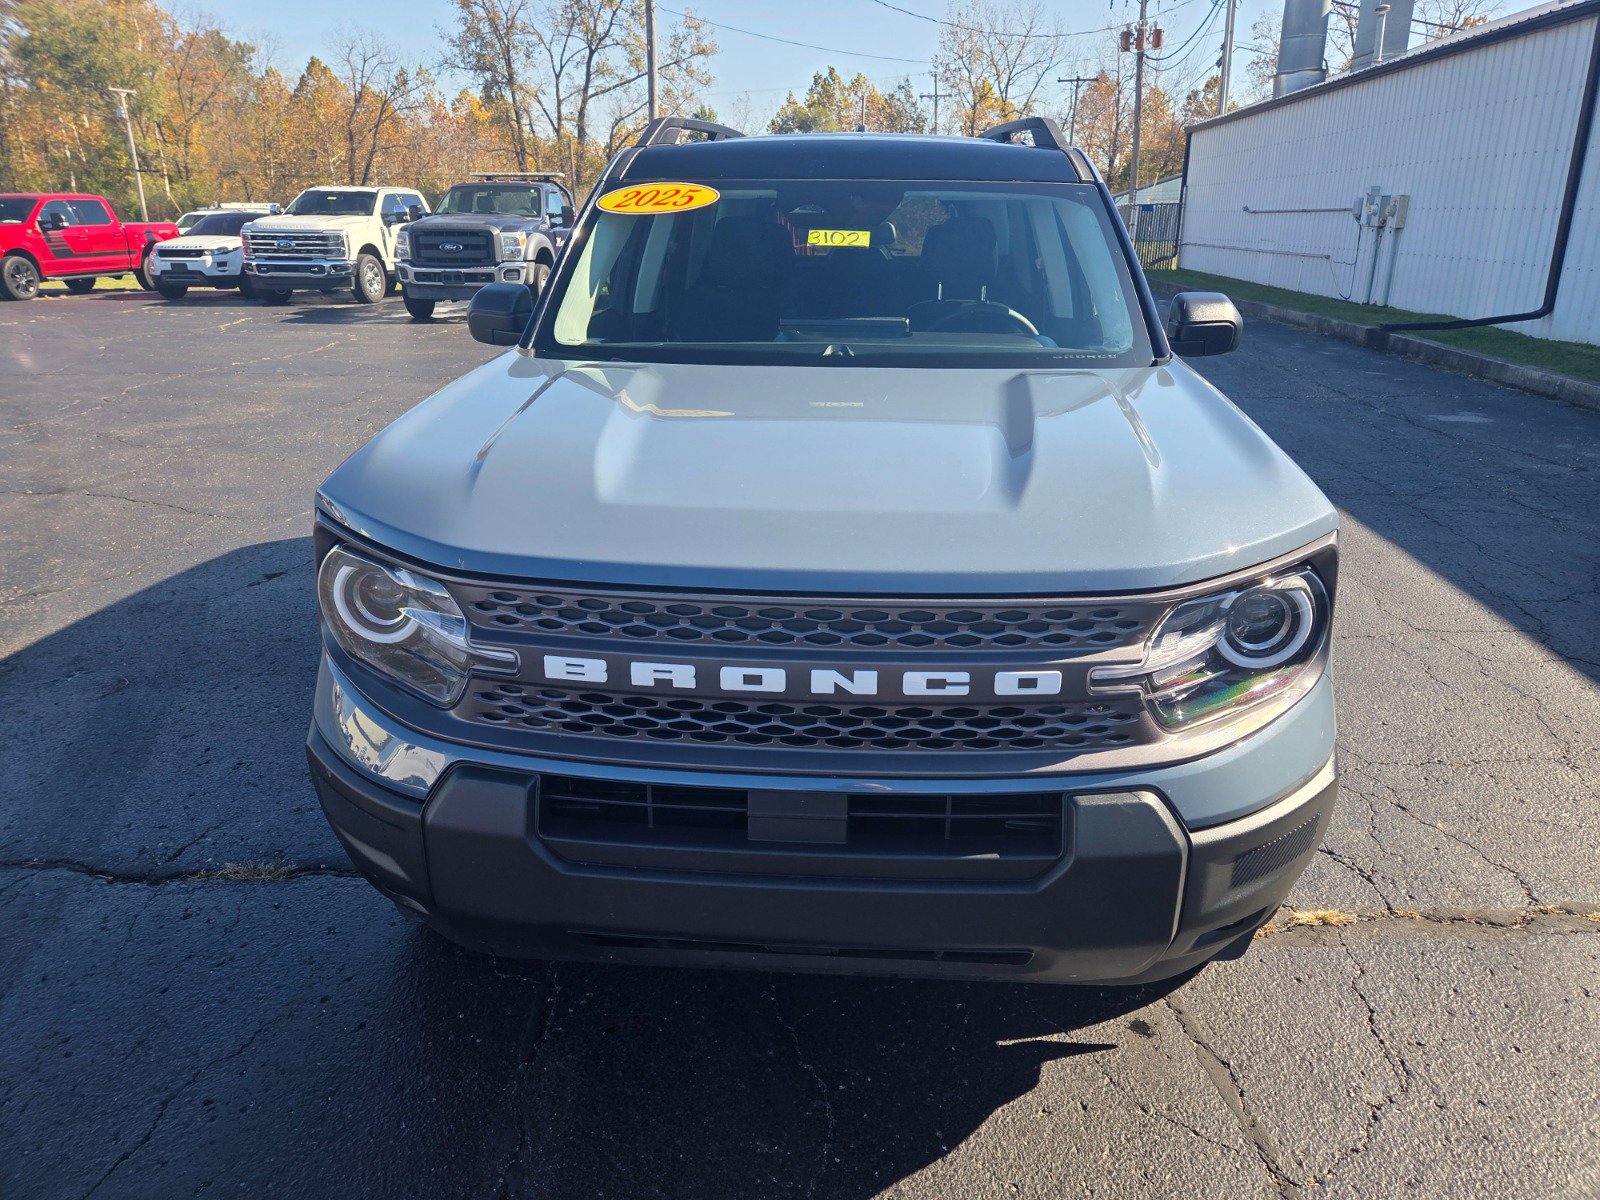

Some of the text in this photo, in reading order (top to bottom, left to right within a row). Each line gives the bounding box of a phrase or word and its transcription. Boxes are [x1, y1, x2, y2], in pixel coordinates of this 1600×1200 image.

[612, 189, 702, 208] 2025
[808, 231, 860, 245] 3102
[543, 654, 1063, 696] BRONCO
